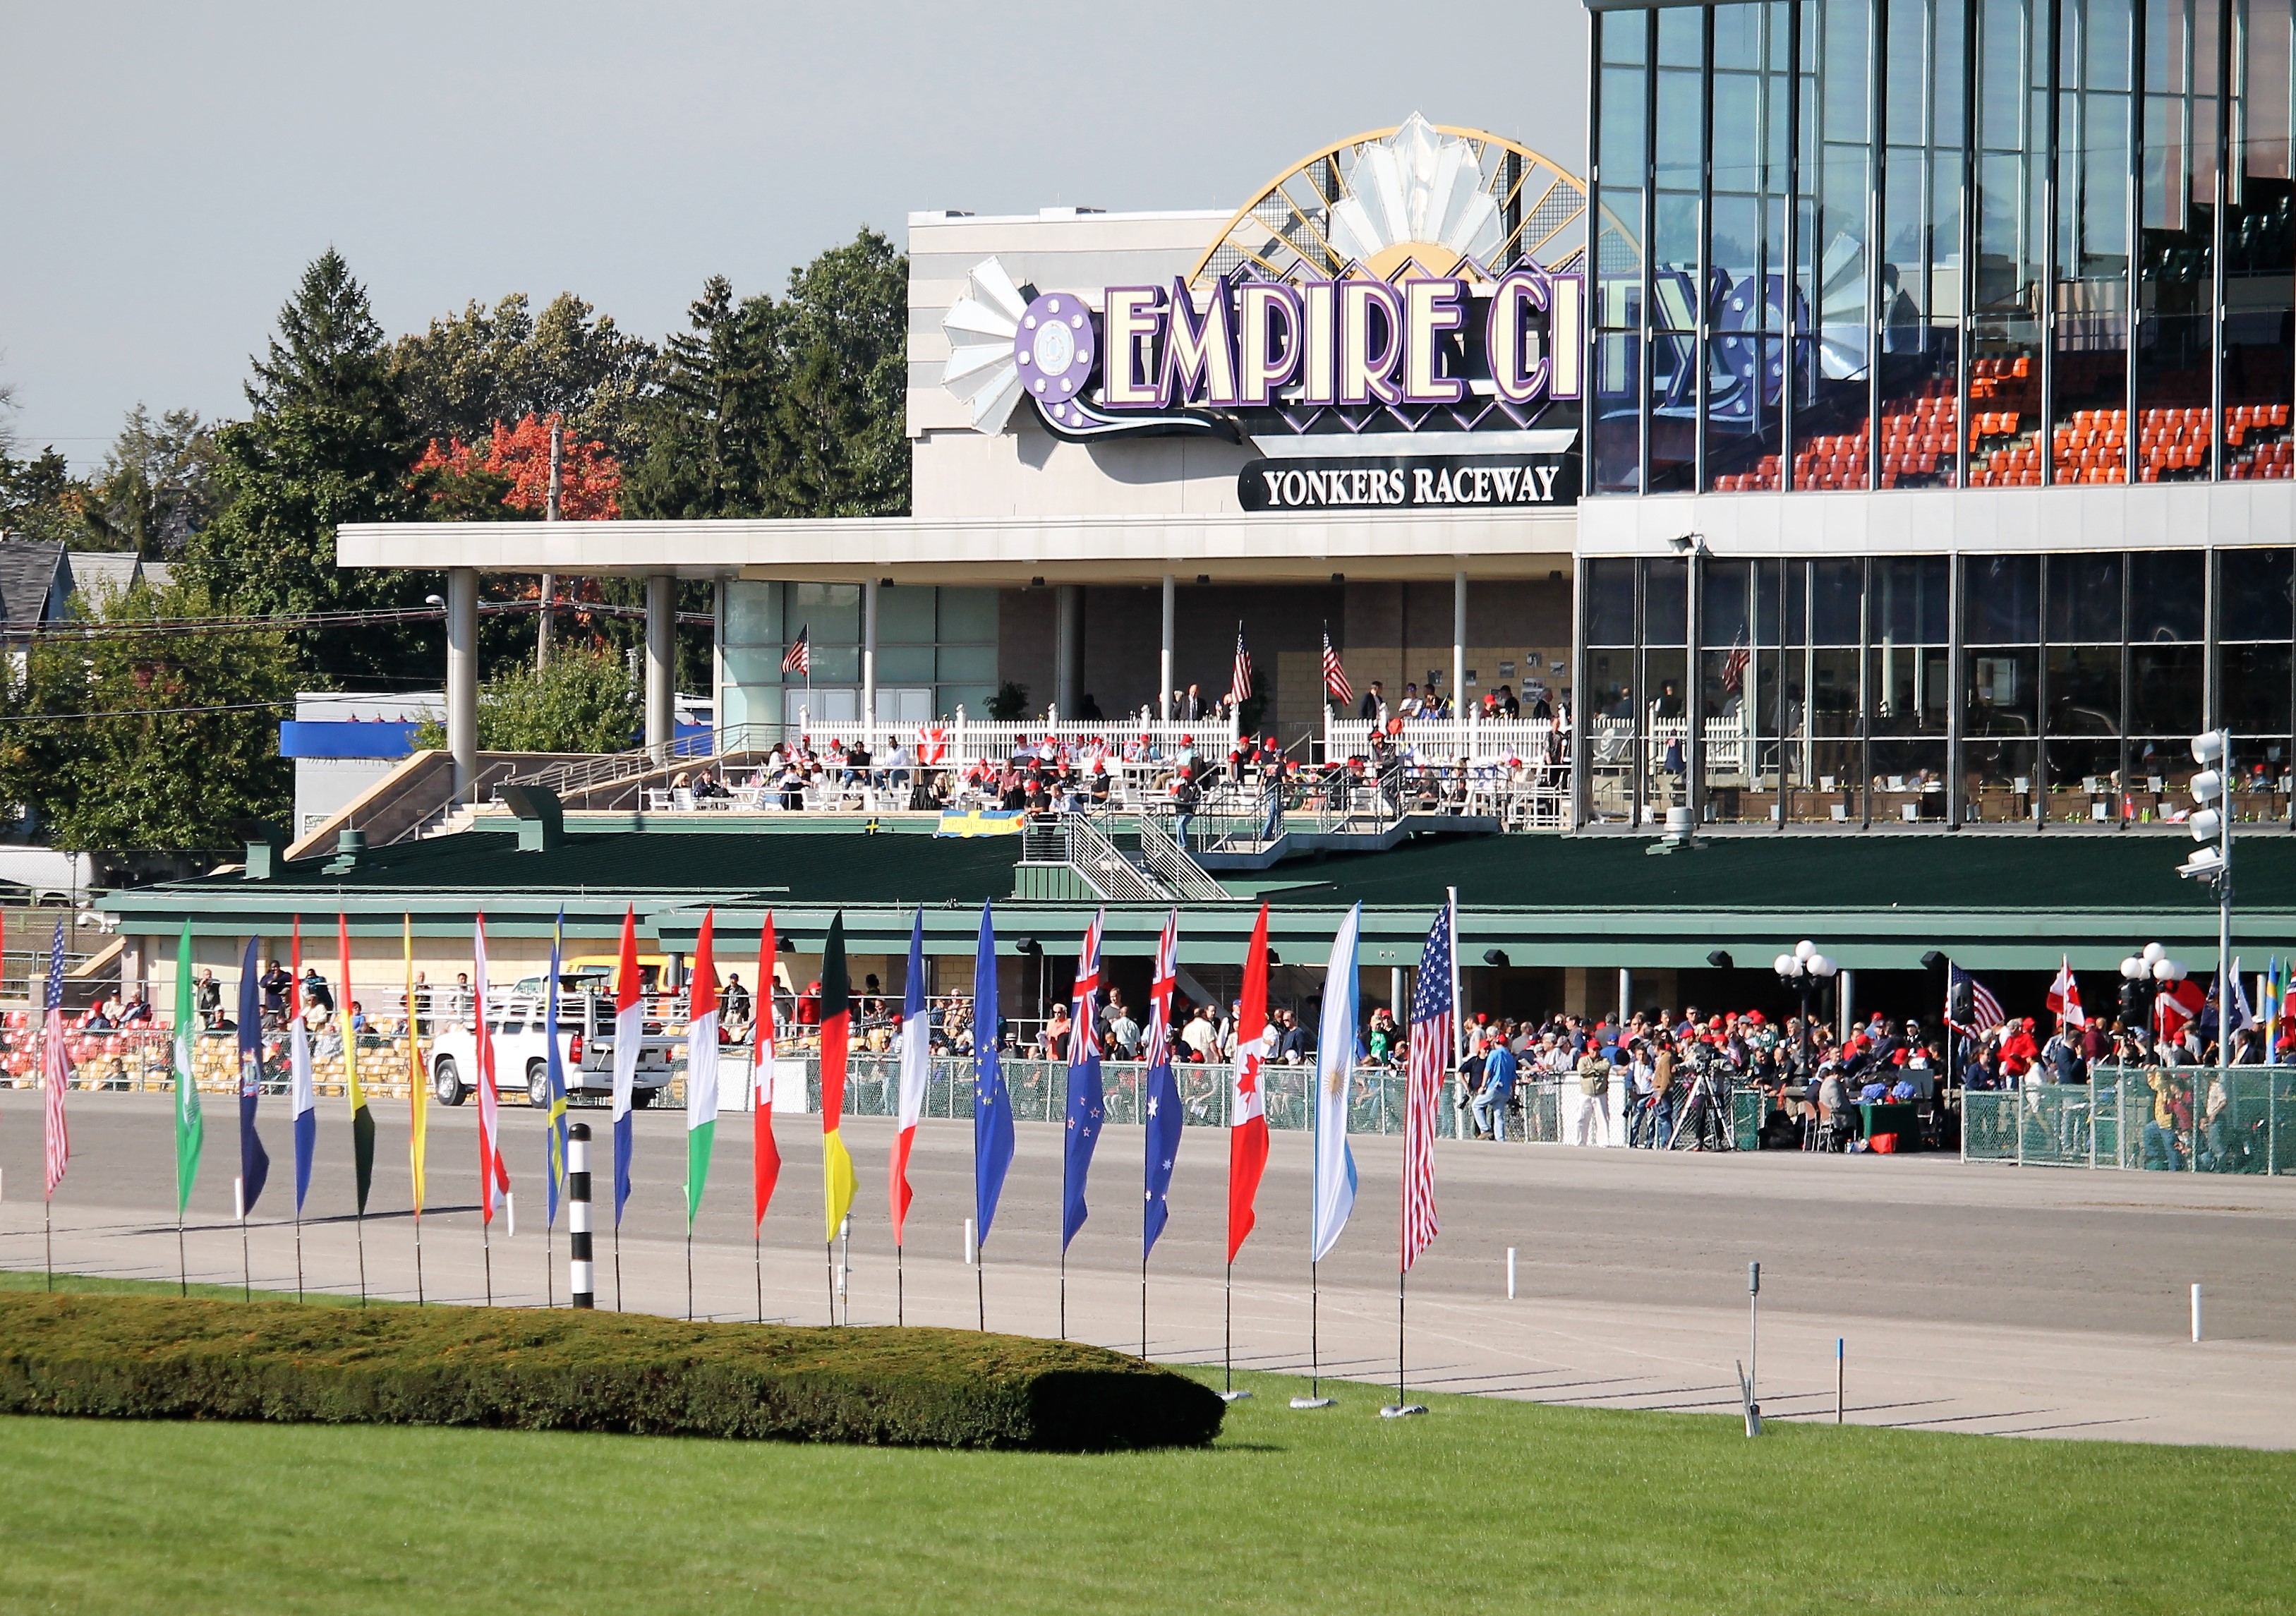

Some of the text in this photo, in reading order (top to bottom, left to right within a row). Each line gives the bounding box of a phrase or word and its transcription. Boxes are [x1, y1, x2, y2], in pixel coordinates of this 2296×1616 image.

[1104, 276, 1468, 409] EMPIRE
[1262, 466, 1560, 506] YONKERS RACEWAY
